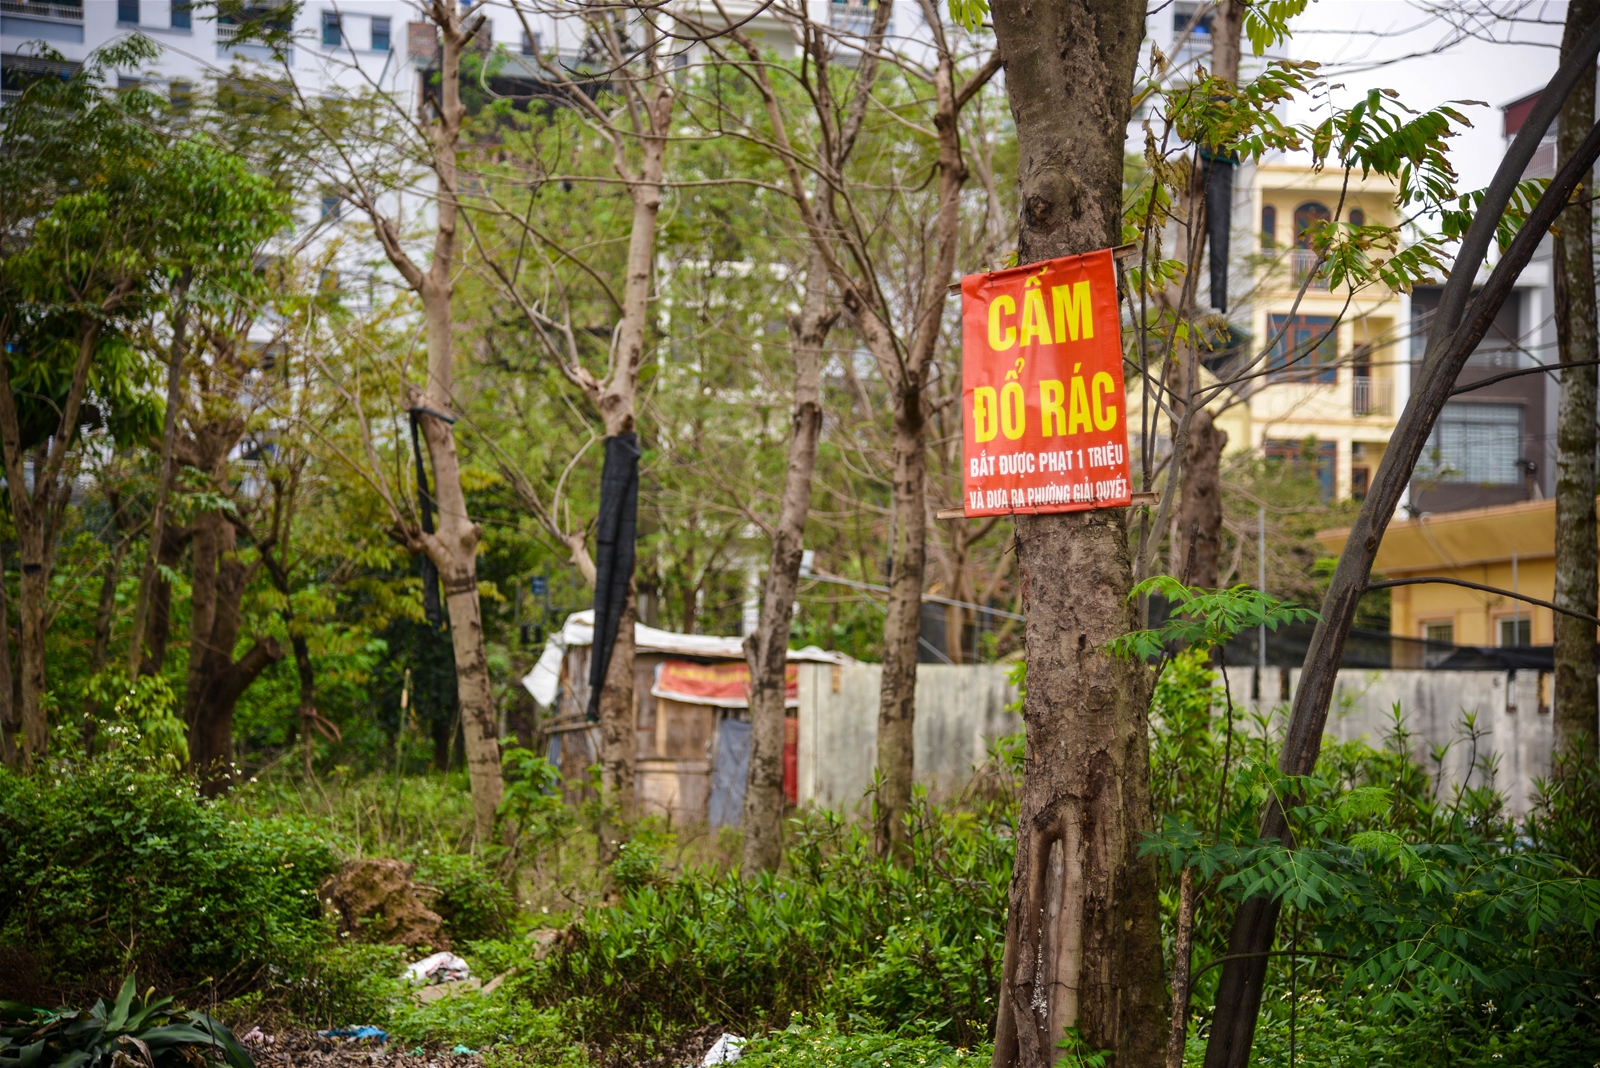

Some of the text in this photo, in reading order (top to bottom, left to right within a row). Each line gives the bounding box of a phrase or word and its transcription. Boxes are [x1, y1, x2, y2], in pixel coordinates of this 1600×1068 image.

[988, 266, 1094, 351] CẤM
[973, 357, 1117, 443] ĐỔ RÁC
[970, 441, 1123, 478] BẮT ĐƯỢC PHẠT 1 TRIỆU
[969, 472, 1127, 509] VÀ ĐƯA RA PHƯỜNG GIẢI QUYẾT
